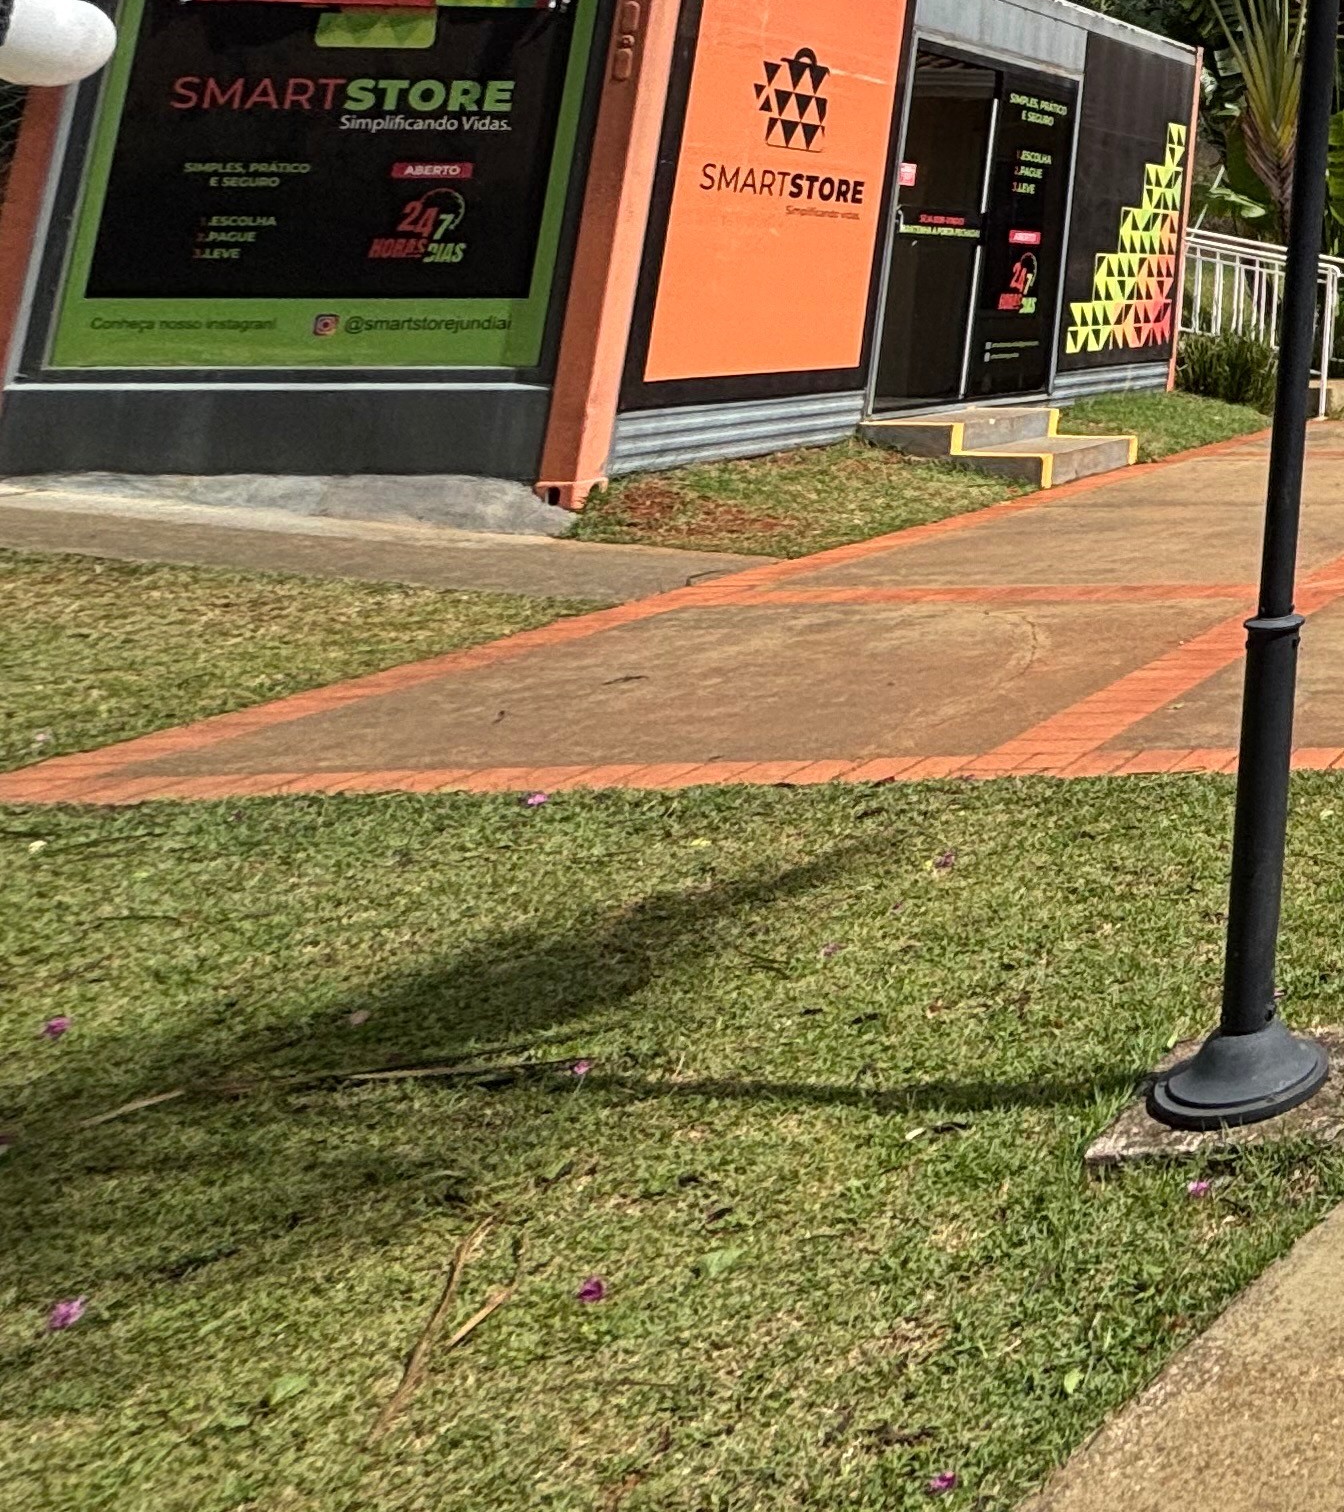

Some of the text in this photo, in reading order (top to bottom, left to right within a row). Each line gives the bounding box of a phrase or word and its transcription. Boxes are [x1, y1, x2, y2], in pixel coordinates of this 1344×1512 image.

[169, 76, 516, 113] SMARTSTORE
[340, 114, 512, 133] Simplificando Vidas.
[403, 164, 462, 176] ABERTO
[699, 162, 865, 205] SMARTSTORE
[367, 238, 428, 259] HORAS
